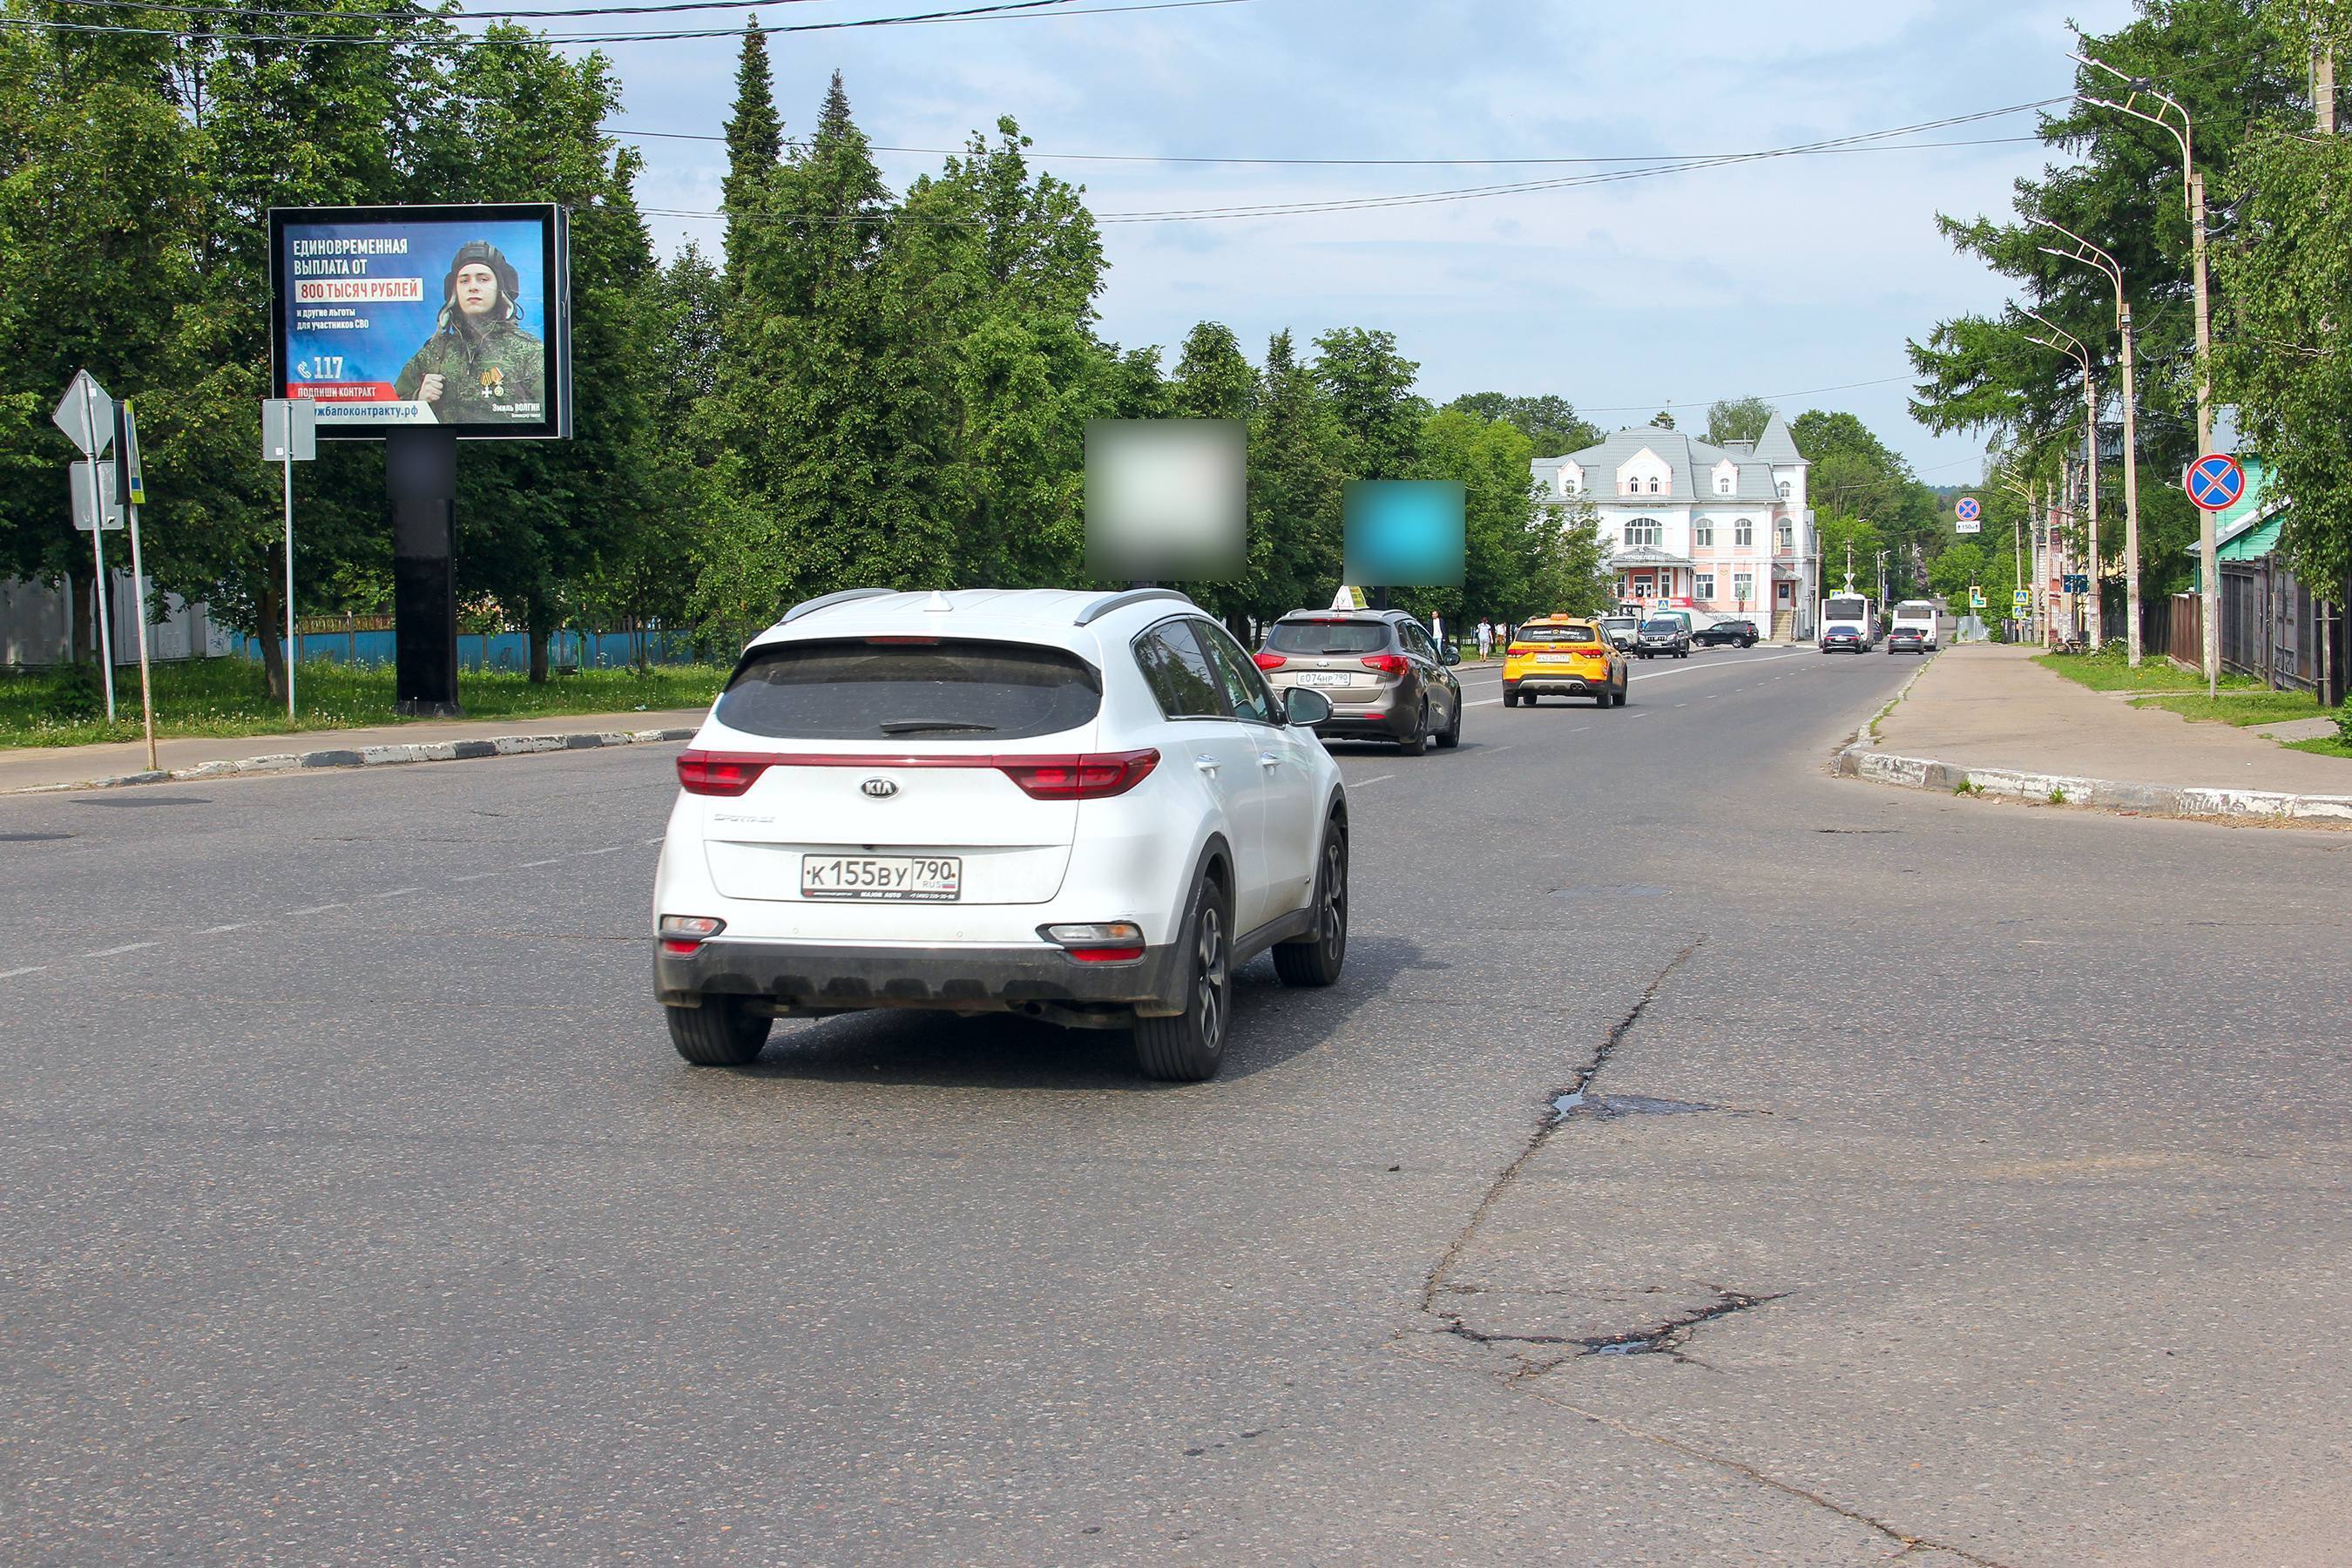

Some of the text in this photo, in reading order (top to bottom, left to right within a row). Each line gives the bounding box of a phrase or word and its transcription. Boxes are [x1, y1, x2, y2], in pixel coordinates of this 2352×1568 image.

[294, 238, 408, 256] ЕДИНОВРЕМЕННАЯ
[294, 259, 368, 275] ВЫПЛАТА ОТ
[301, 279, 417, 299] 800 ТЫСЯЧ РУБЛЕЙ
[303, 309, 328, 319] другие
[329, 308, 355, 317] льготы
[311, 321, 354, 331] участников
[355, 320, 369, 328] СВО
[314, 356, 343, 379] 117
[298, 387, 376, 398] ПОДПИШИ КОНТРАКТ
[865, 781, 896, 794] KIA
[915, 860, 952, 881] 790
